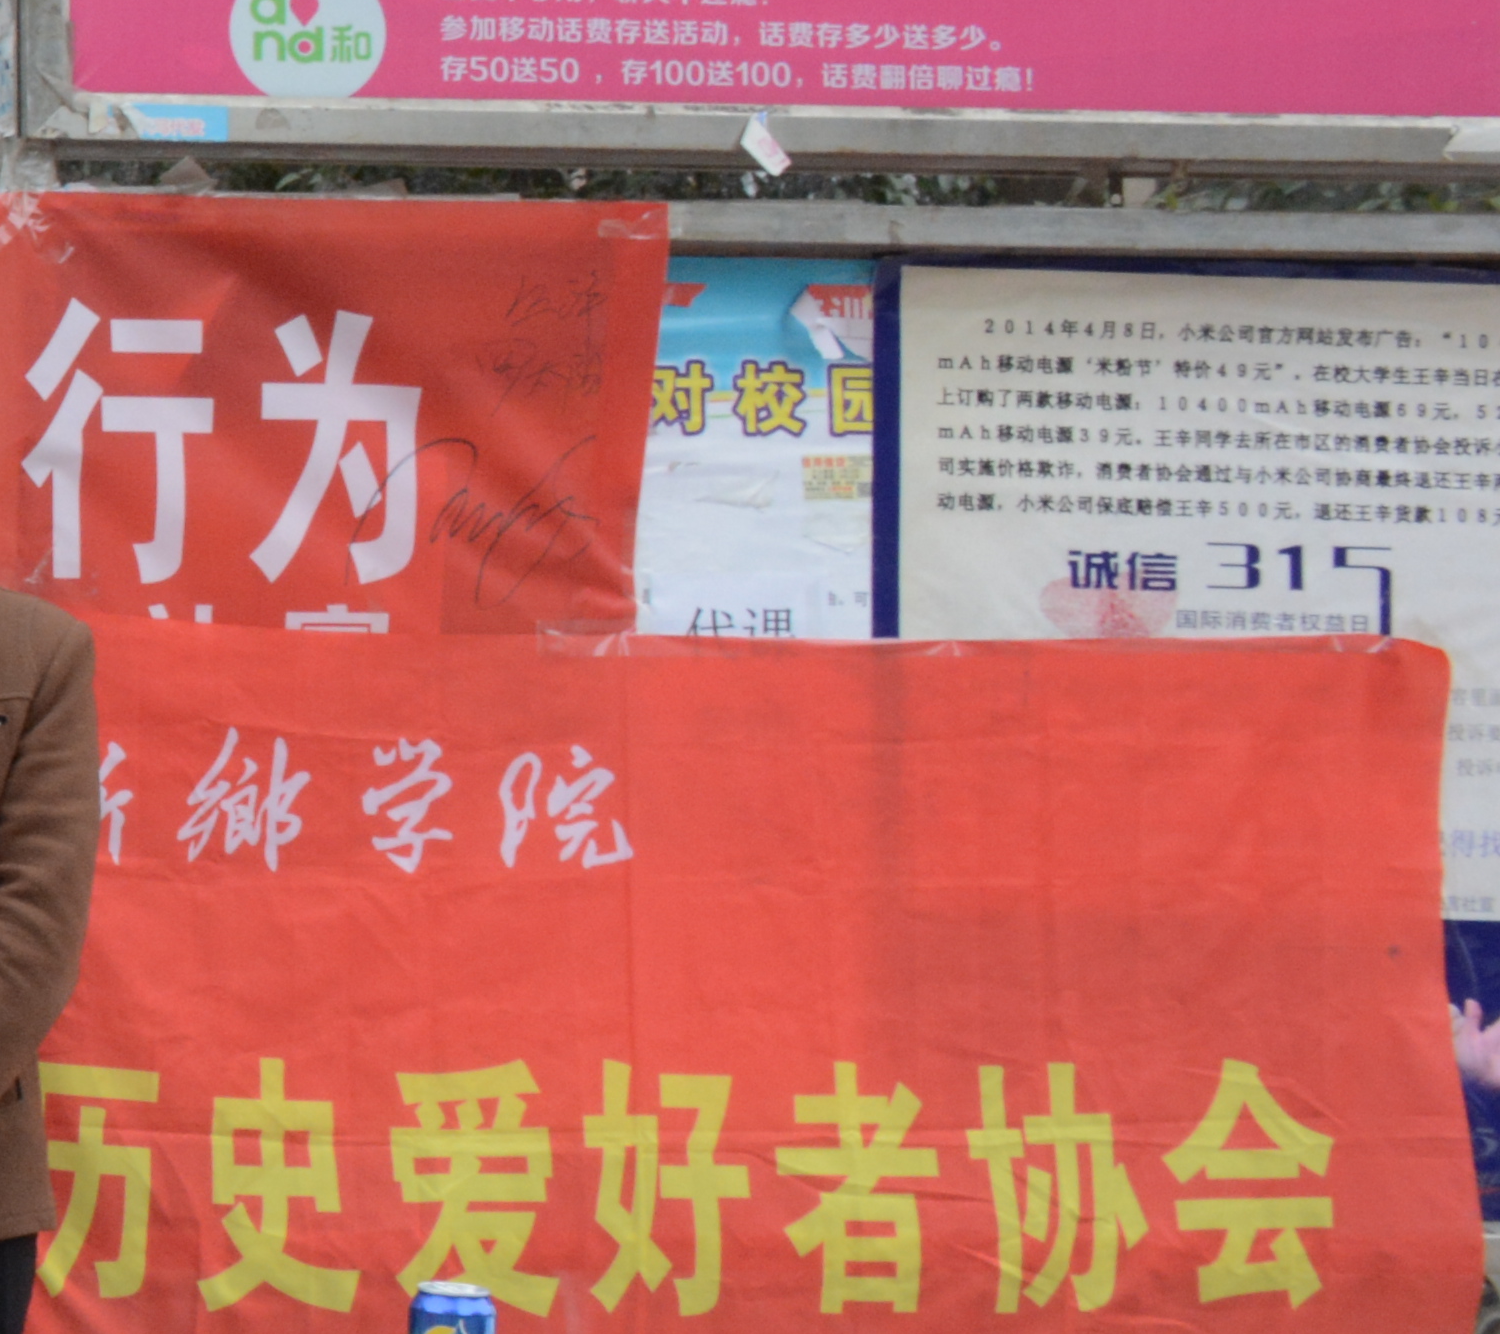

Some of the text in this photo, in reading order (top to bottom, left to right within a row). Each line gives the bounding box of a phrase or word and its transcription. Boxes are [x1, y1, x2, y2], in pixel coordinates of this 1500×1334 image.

[1067, 542, 1393, 637] 诚信 315
[1176, 609, 1370, 634] 国际消费者权益日
[34, 1056, 1334, 1317] 历史爱好者协会
